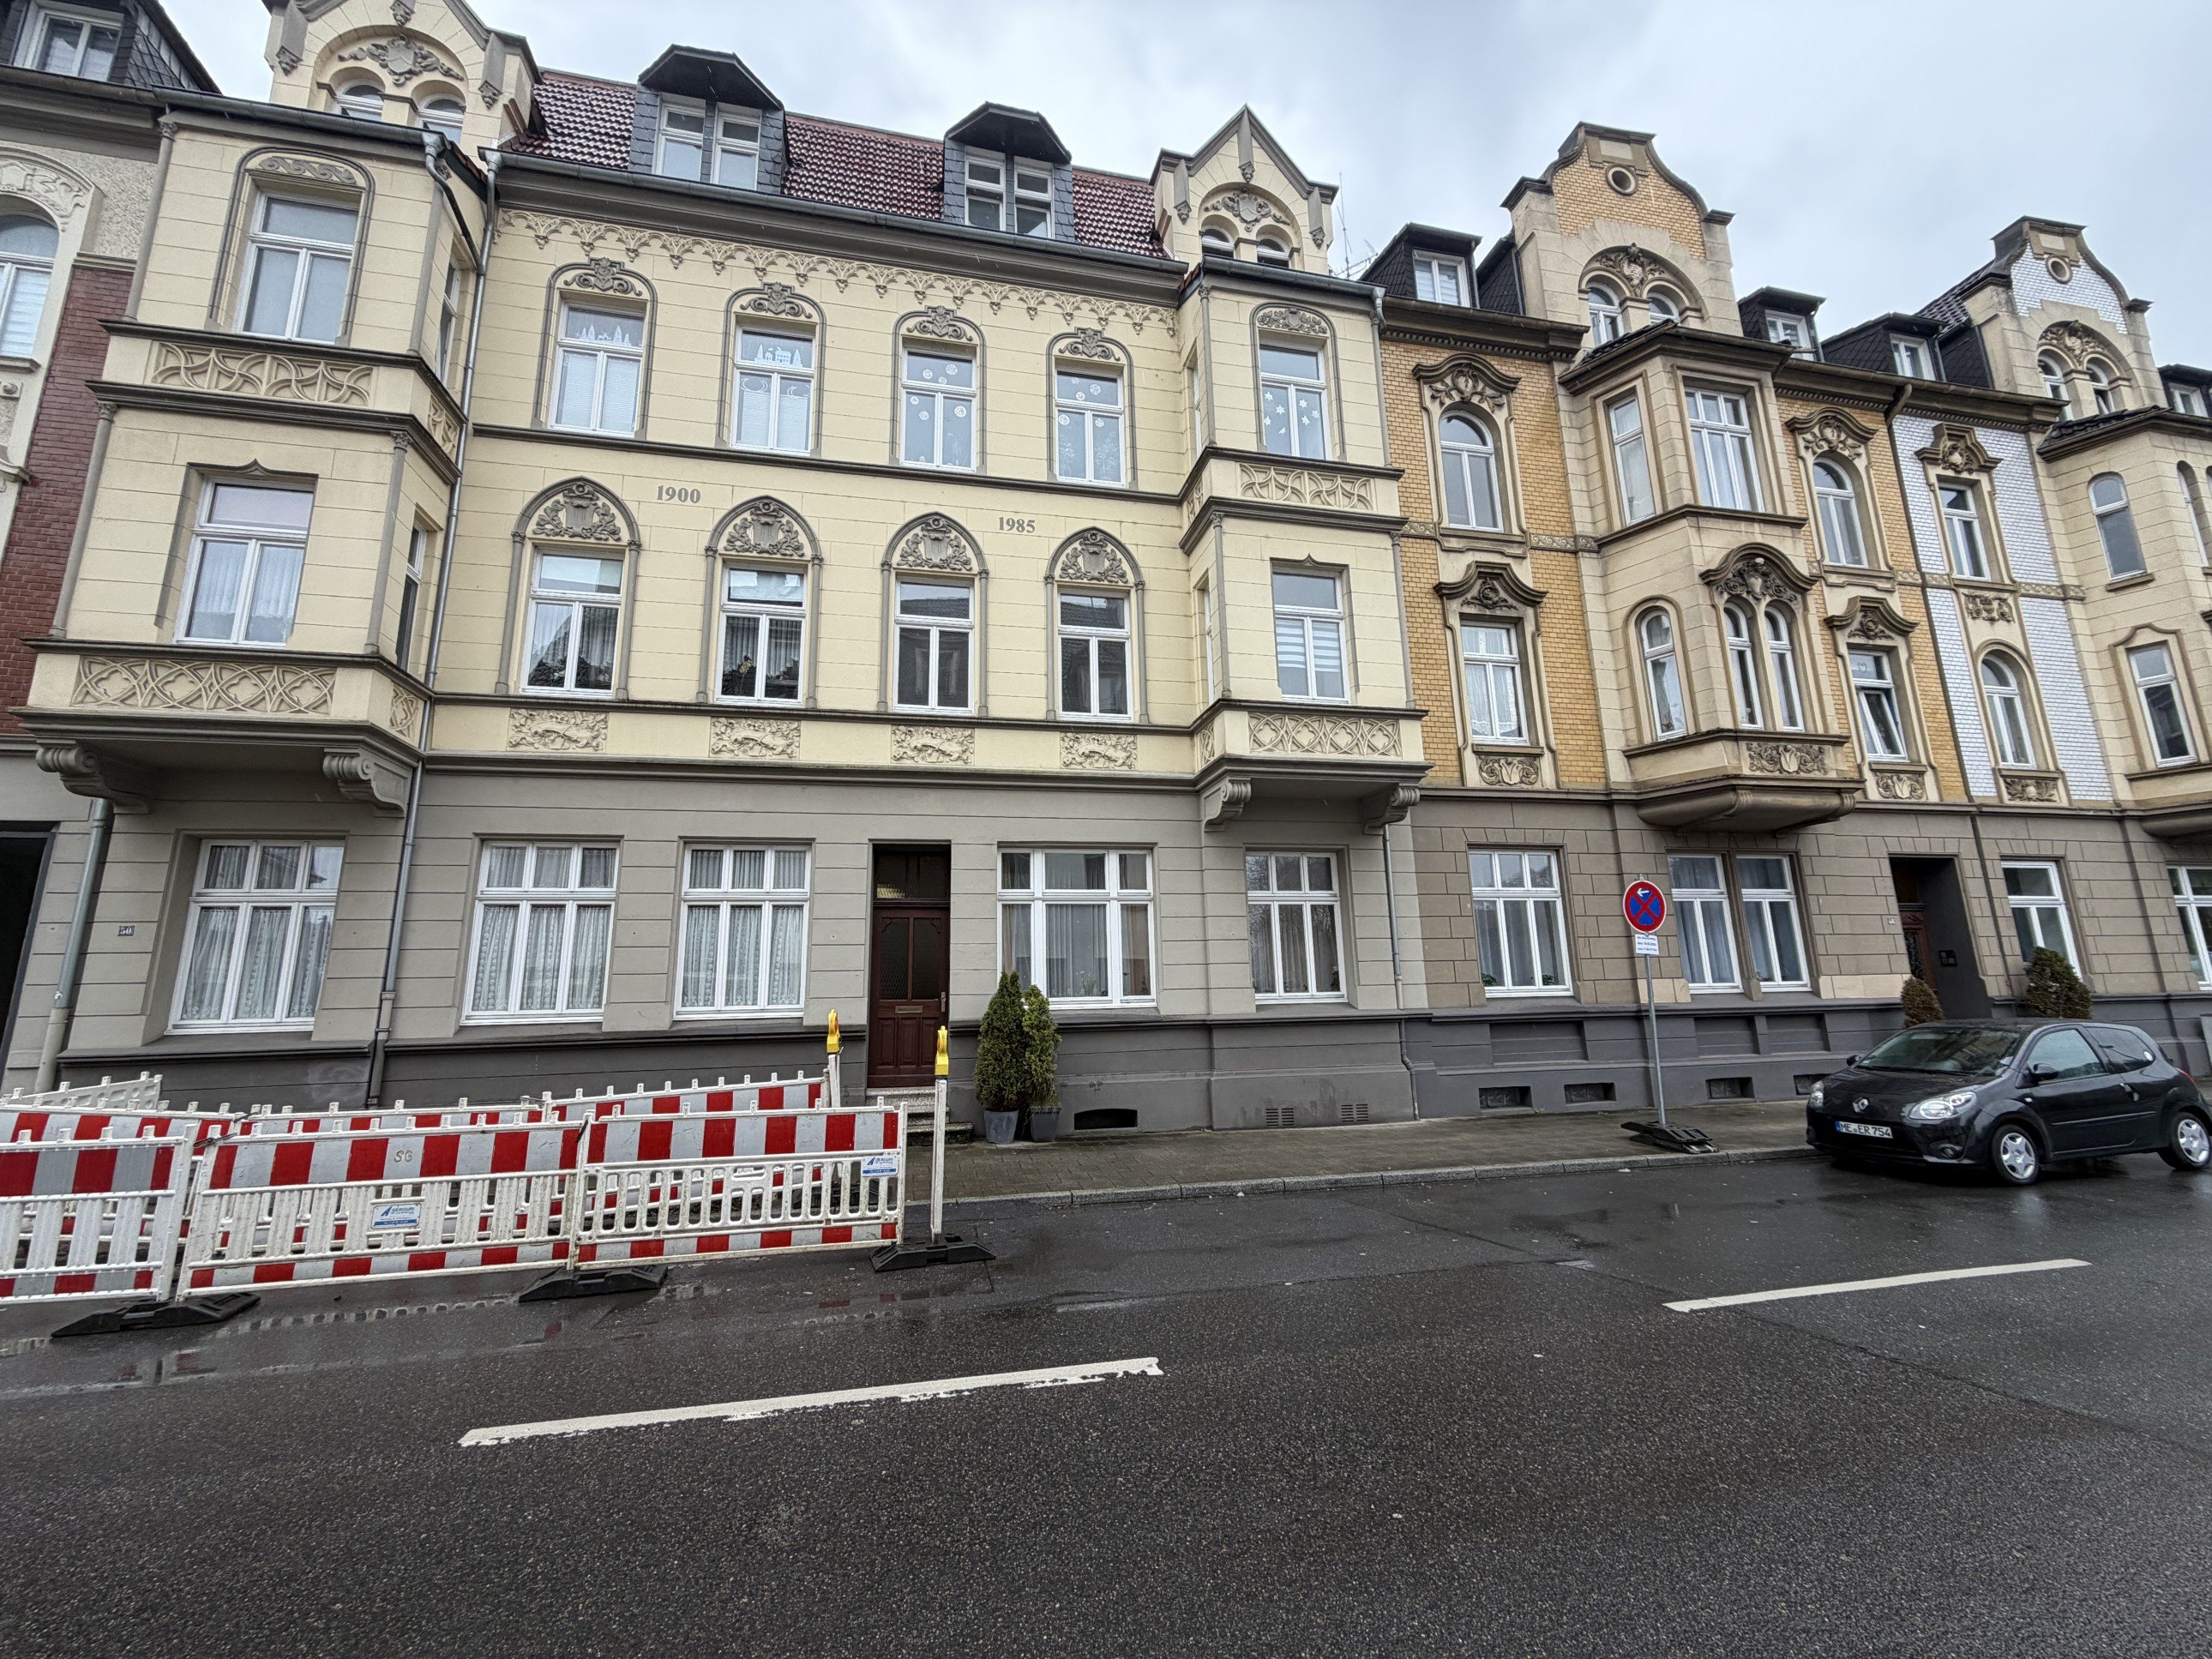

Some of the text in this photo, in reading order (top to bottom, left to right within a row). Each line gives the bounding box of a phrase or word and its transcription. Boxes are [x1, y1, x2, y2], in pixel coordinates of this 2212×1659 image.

[657, 485, 701, 504] 1900
[999, 516, 1036, 533] 1985
[120, 926, 133, 935] 50
[1840, 1123, 1891, 1138] ME ER 754
[394, 1150, 412, 1163] SG
